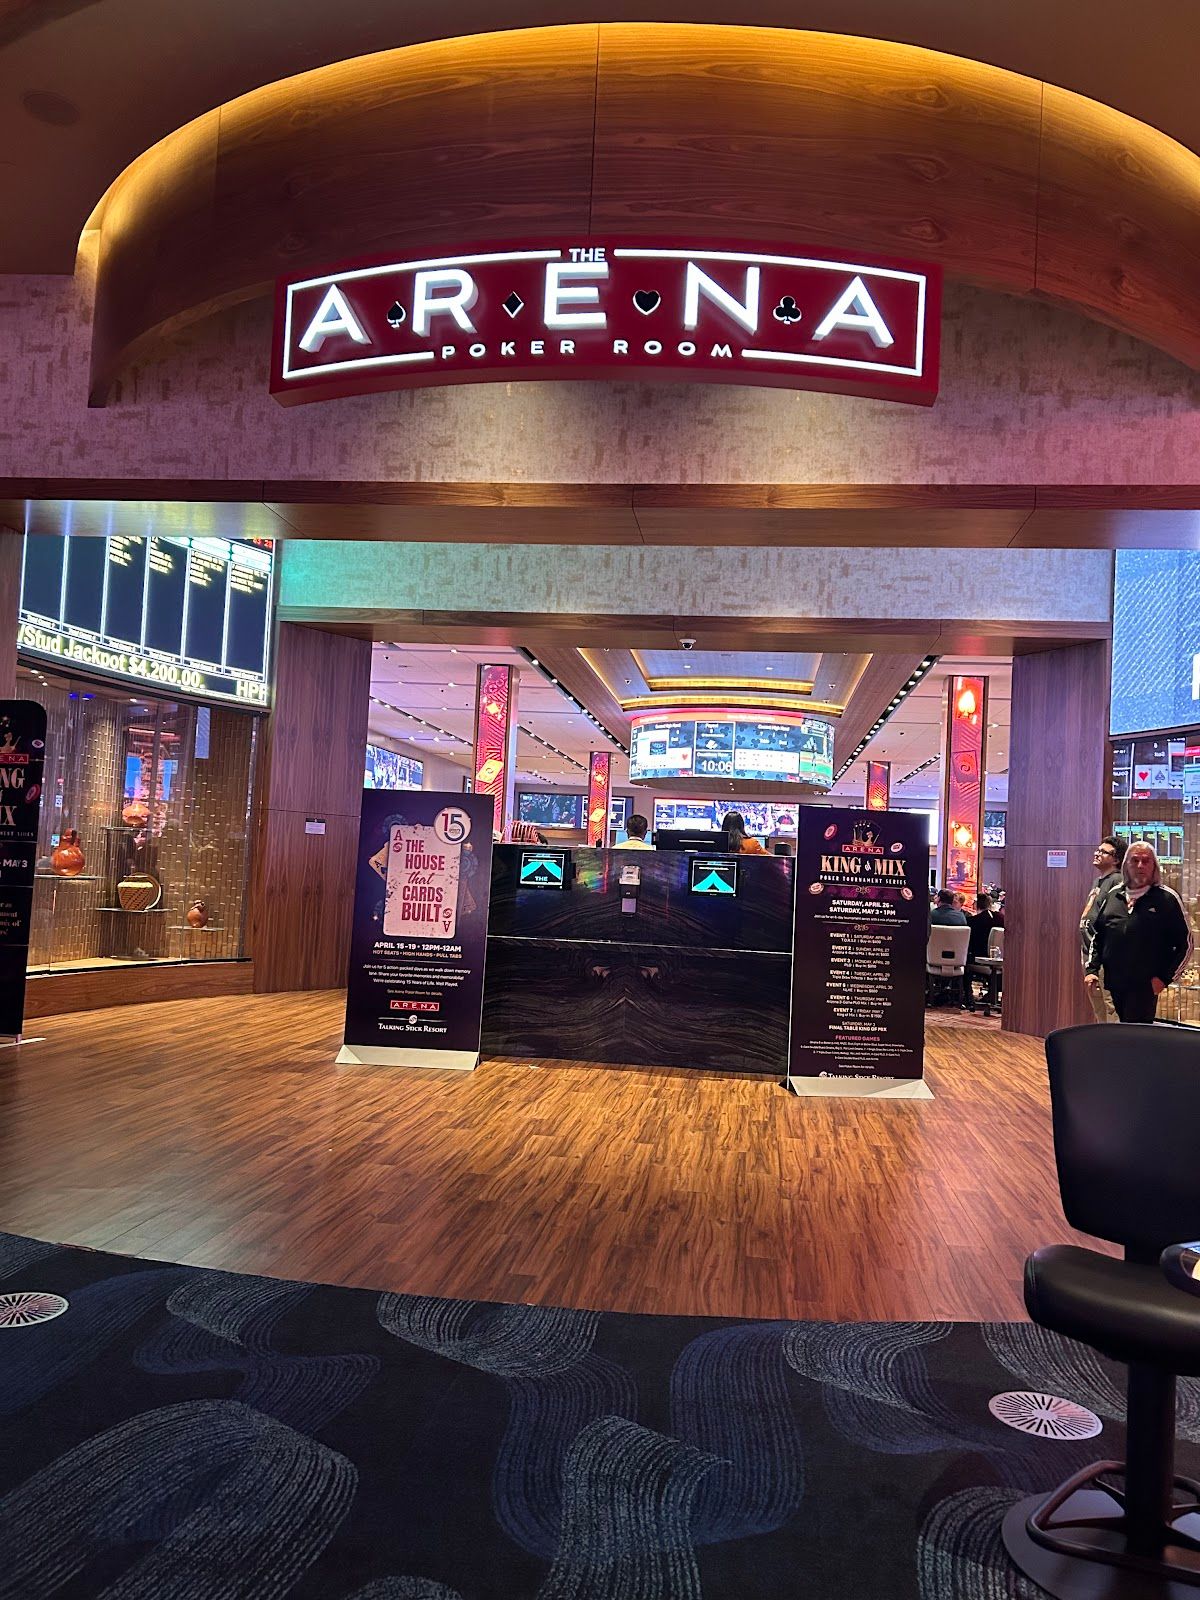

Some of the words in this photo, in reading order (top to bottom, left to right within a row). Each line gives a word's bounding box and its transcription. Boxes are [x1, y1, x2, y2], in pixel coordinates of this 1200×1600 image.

[568, 248, 606, 262] THE
[299, 261, 895, 350] ARENA
[441, 340, 575, 359] POKER
[613, 338, 734, 358] ROOM
[64, 638, 127, 672] Jackpot
[702, 760, 732, 772] 10:06
[394, 830, 403, 840] A
[406, 840, 424, 853] THE
[3, 860, 20, 868] MAY
[405, 854, 445, 870] HOUSE
[820, 855, 861, 874] KING
[874, 859, 906, 877] MIX
[407, 870, 435, 884] that
[402, 885, 443, 902] CARDS
[401, 902, 442, 922] BUILT
